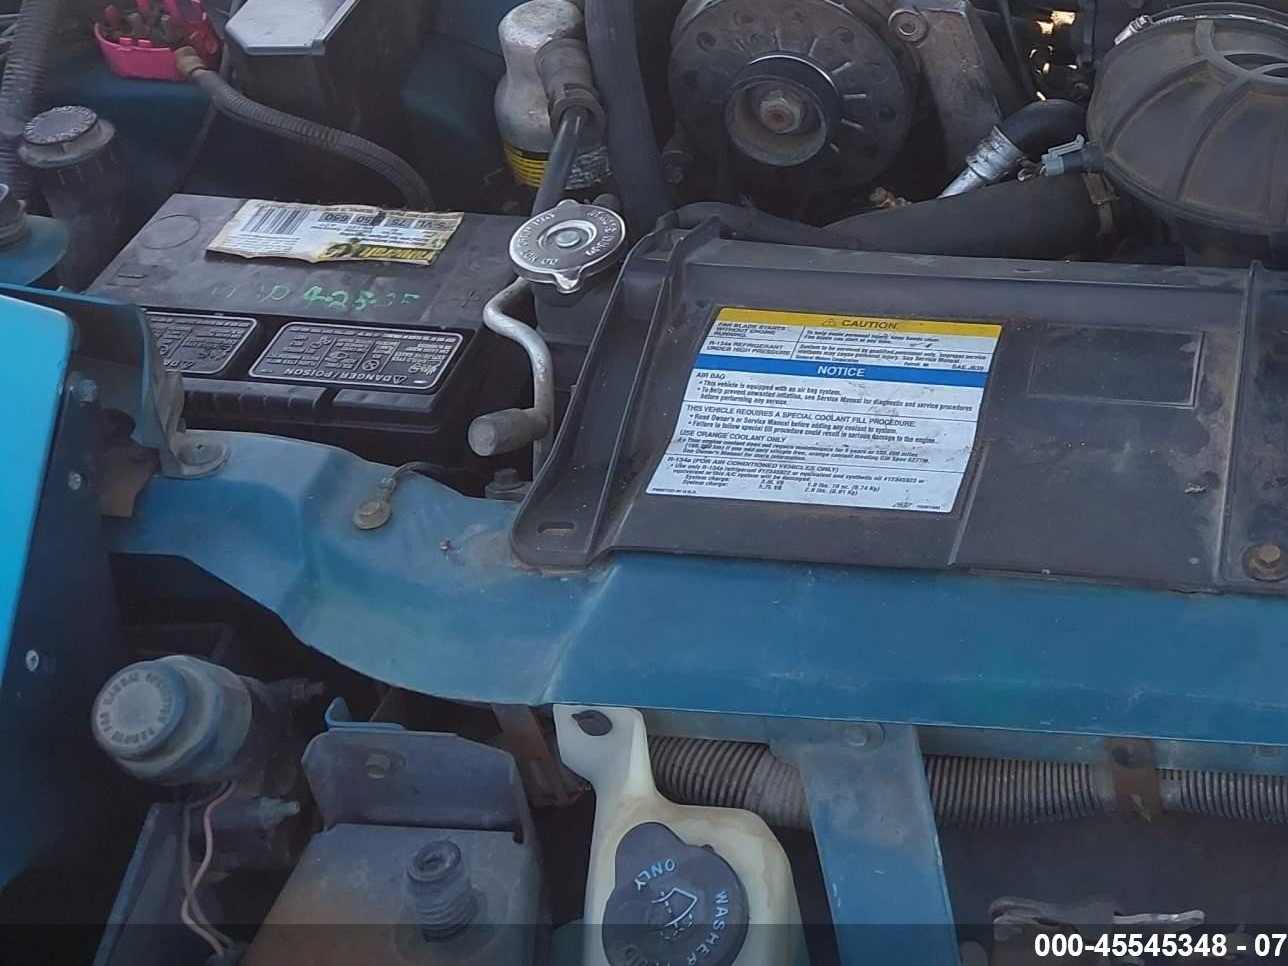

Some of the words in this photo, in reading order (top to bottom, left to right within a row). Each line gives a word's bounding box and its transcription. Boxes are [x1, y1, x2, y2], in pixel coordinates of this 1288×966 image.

[842, 319, 899, 330] CAUTION
[817, 366, 866, 377] NOTICE
[633, 858, 676, 891] ONLY
[686, 891, 729, 965] WASHER
